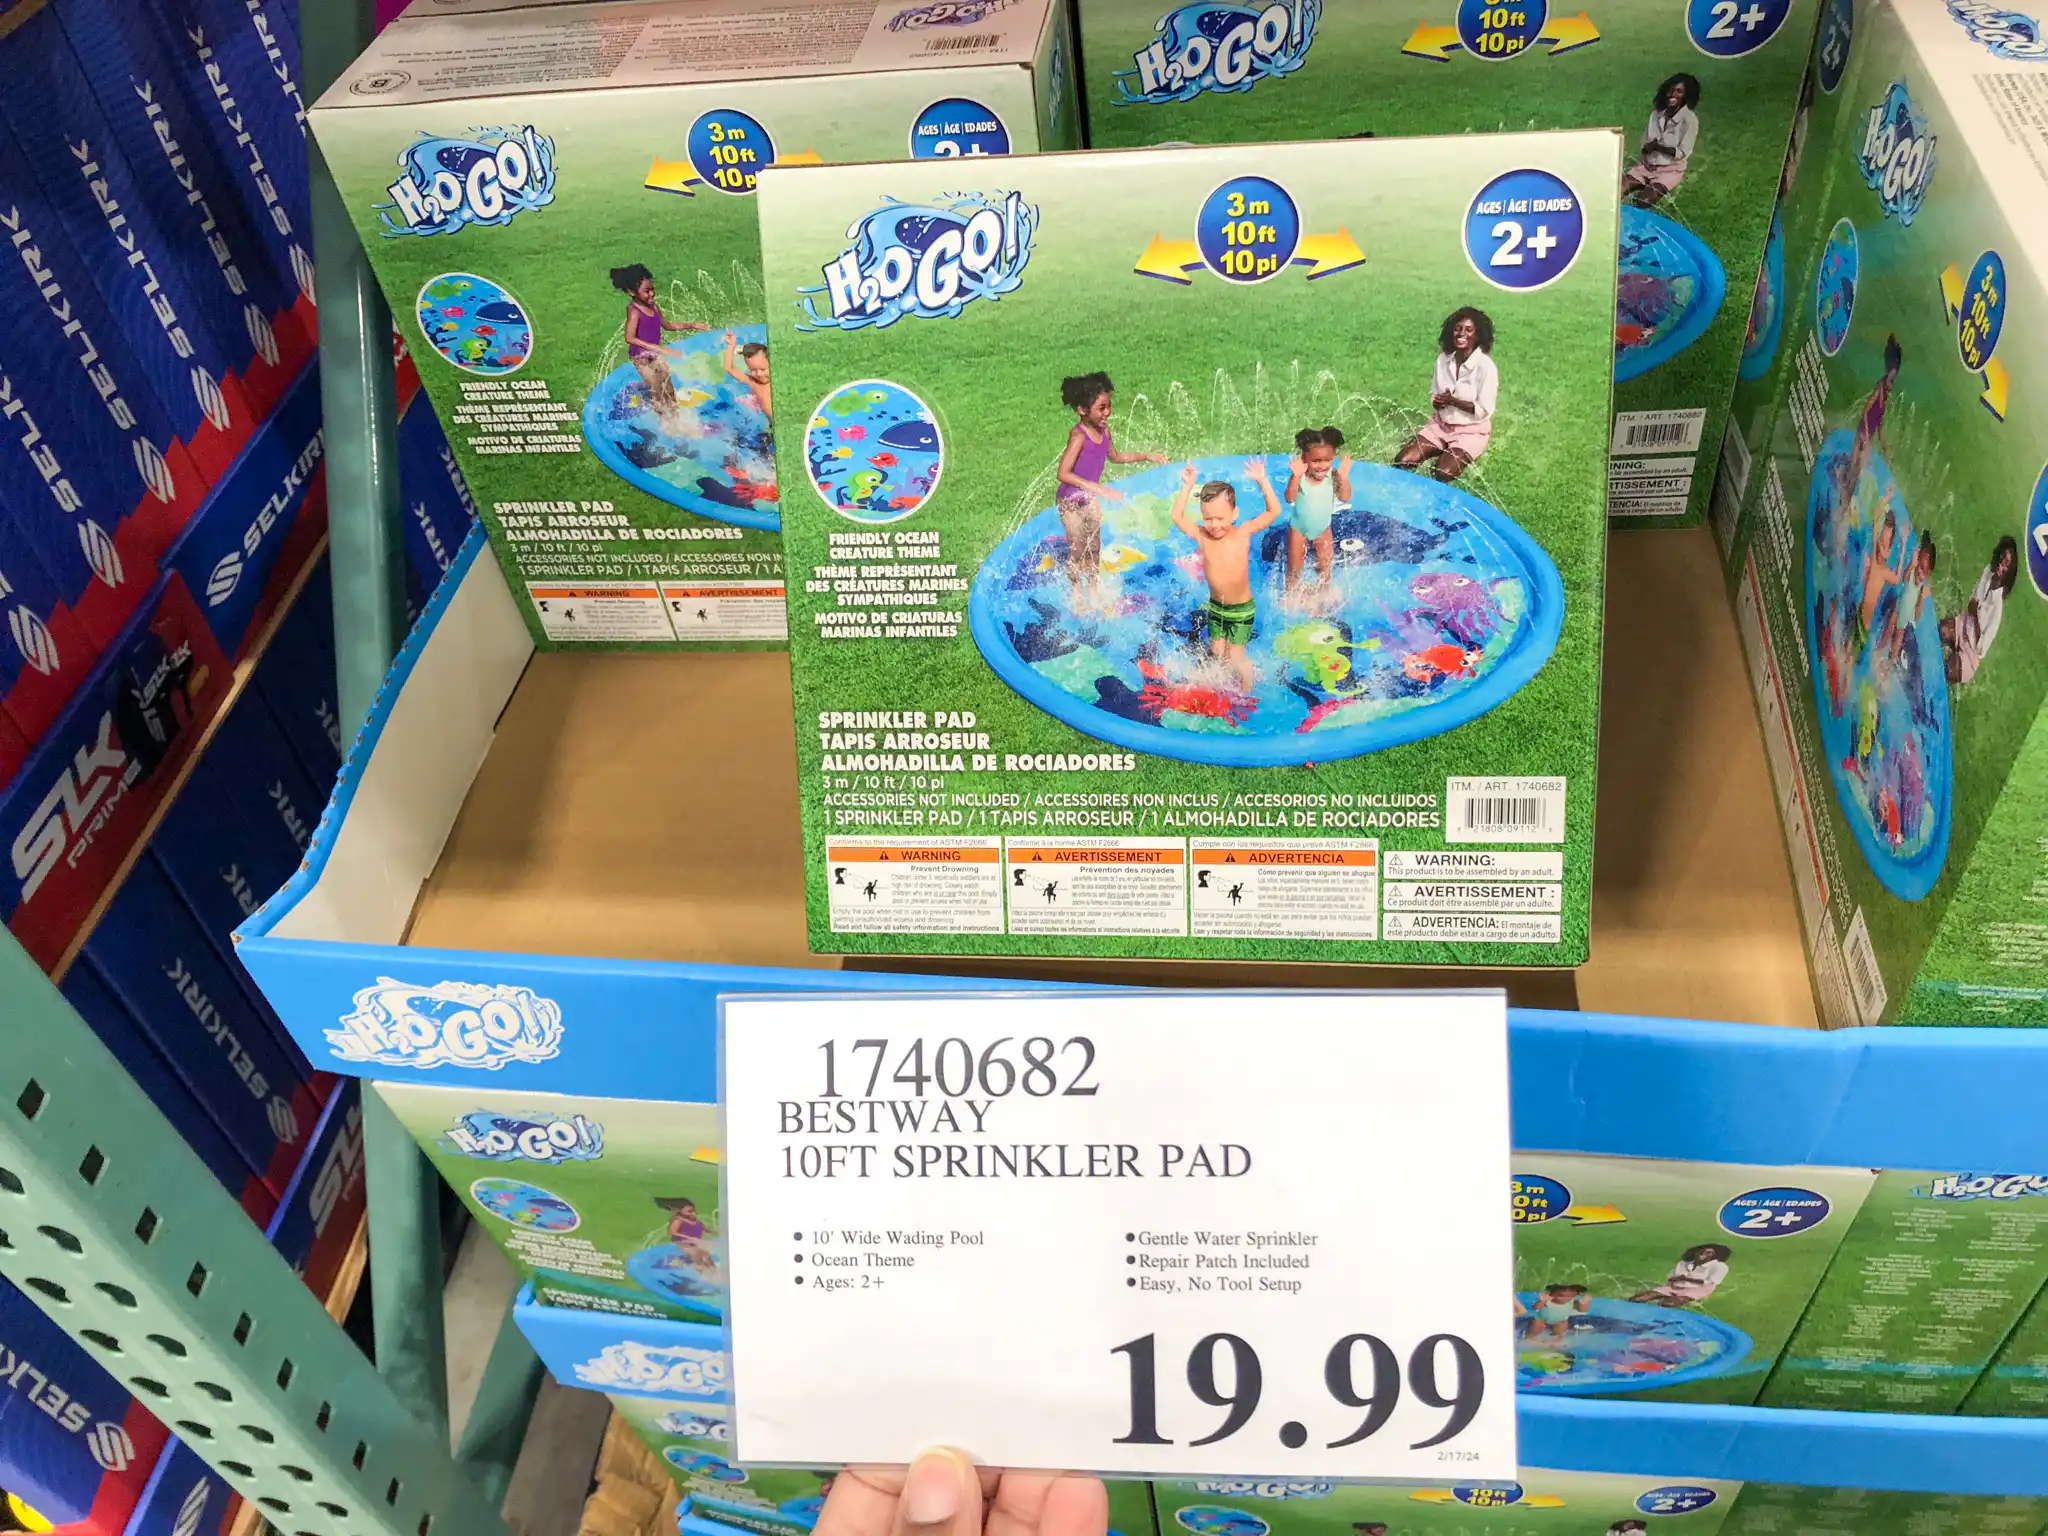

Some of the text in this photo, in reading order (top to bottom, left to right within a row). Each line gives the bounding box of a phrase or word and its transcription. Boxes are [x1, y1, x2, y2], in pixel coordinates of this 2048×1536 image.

[1478, 9, 1525, 28] 10 ft
[1706, 0, 1765, 39] 2+
[1475, 33, 1524, 53] 10 pi
[186, 23, 293, 237] SELKIRK
[707, 122, 745, 142] 3 m
[918, 125, 939, 135] AGES
[965, 121, 997, 133] EDADES
[709, 145, 756, 165] 10 ft
[713, 168, 743, 188] 10
[134, 78, 248, 296] SELKIRK
[1226, 192, 1269, 217] 3 m
[1476, 201, 1501, 215] AGES
[1532, 198, 1572, 212] EDADES
[1221, 221, 1276, 246] 10 ft
[71, 138, 195, 358] SELKIRK
[1490, 221, 1557, 266] 2+
[1220, 250, 1277, 275] 10 pi
[0, 362, 83, 513] SELK
[243, 427, 324, 558] SELKIR
[493, 501, 614, 514] SPRINKLER PAD
[499, 515, 630, 528] TAPIS ARROSEUR
[506, 528, 742, 541] ALMOHADILLA DE ROCIADORES
[829, 532, 939, 546] FRIENDLY OCEAN
[829, 546, 940, 559] CREATURE THEME
[814, 563, 957, 578] THÈME REPRÉSENTANT
[805, 577, 968, 593] DES CRÉATURES MARINES
[837, 593, 937, 606] SYMPATHIQUES
[815, 612, 962, 624] MOTIVO DE CRIATURAS
[821, 626, 957, 638] MARINAS INFANTILES
[818, 711, 976, 729] SPRINKLER PAD
[819, 732, 990, 750] TAPIS ARROSEUR
[821, 754, 1136, 771] ALMOHADILLA DE ROCIADORES
[822, 776, 831, 788] 3
[835, 778, 848, 788] m
[864, 776, 880, 788] 10
[884, 776, 895, 788] ft
[910, 776, 926, 788] 10
[931, 776, 944, 791] pi
[1516, 781, 1561, 791] 1740682
[823, 793, 916, 806] ACCESSORIES
[919, 793, 947, 806] NOT
[952, 793, 1020, 806] INCLUDED
[1034, 793, 1129, 807] ACCESSOIRES
[1133, 793, 1164, 807] NON
[1169, 793, 1219, 807] INCLUS
[1234, 794, 1326, 807] ACCESORIOS
[1331, 794, 1353, 807] NO
[1357, 794, 1437, 807] INCLUIDOS
[824, 810, 830, 825] 1
[835, 810, 923, 825] SPRINKLER
[929, 810, 962, 825] PAD
[979, 811, 985, 825] 1
[990, 810, 1037, 825] TAPIS
[1043, 810, 1134, 826] ARROSEUR
[1152, 811, 1157, 825] 1
[1163, 811, 1288, 827] ALMOHADILLA
[1294, 811, 1316, 827] DE
[1323, 812, 1440, 827] ROCIADORES
[901, 851, 961, 861] WARNING
[1055, 851, 1162, 862] AVERTISSEMENT
[1249, 853, 1345, 864] ADVERTENCIA
[1415, 854, 1496, 866] WARNING:
[910, 865, 979, 874] Prevent Drowning
[1388, 866, 1403, 876] This
[1405, 867, 1436, 877] product
[1437, 867, 1443, 875] is
[1445, 867, 1453, 875] to
[1454, 867, 1465, 876] be
[1466, 867, 1507, 876] assembled
[1509, 867, 1519, 878] by
[1414, 886, 1546, 898] AVERTISSEMENT
[1412, 916, 1499, 928] ADVERTENCIA:
[1510, 921, 1541, 930] montaje
[1542, 921, 1552, 929] de
[818, 1036, 1099, 1097] 1740682
[778, 1100, 995, 1133] BESTWAY
[781, 1143, 1252, 1178] 10FT SPRINKLER PAD
[1739, 1210, 1801, 1229] 2+
[813, 1231, 984, 1248] 10' Wide Wading Pool
[1138, 1231, 1318, 1249] Gentle Water Sprinkler
[812, 1253, 914, 1267] Ocean Theme
[1139, 1253, 1309, 1271] Repair Patch Included
[813, 1275, 885, 1291] Ages: 2+
[1140, 1276, 1302, 1294] Easy, No Tool Setup
[0, 1344, 91, 1433] SELK
[1110, 1332, 1485, 1451] 19.99
[1437, 1451, 1480, 1462] 2/17/24
